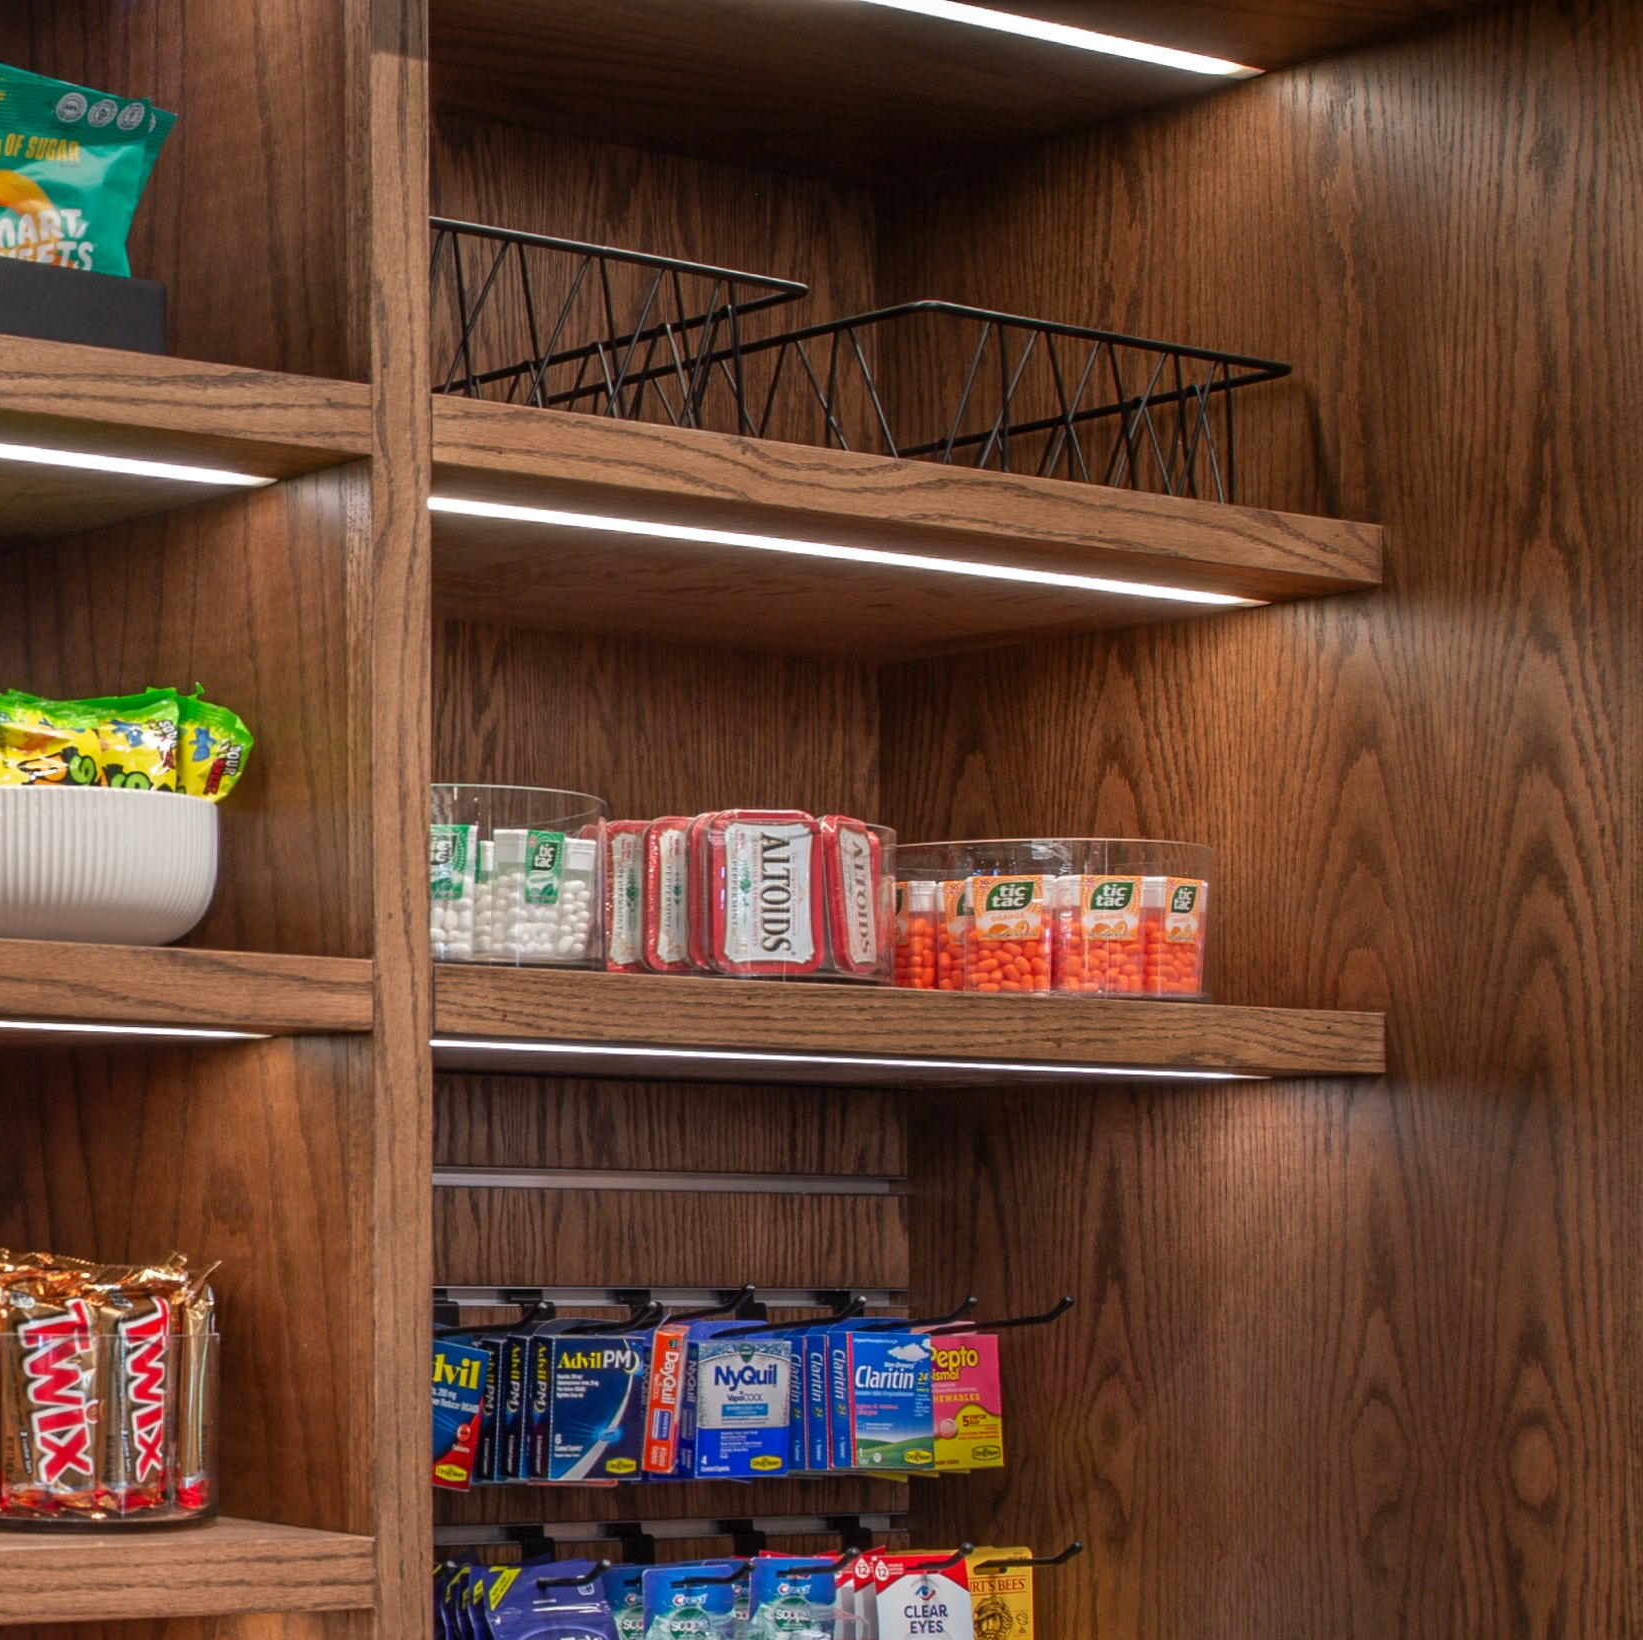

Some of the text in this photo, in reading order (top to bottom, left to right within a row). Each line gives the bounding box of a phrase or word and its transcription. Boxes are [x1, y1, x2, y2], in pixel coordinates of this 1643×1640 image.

[6, 129, 24, 157] OF
[26, 137, 80, 164] SUGAR
[538, 841, 556, 857] tic
[534, 855, 552, 870] tac
[761, 831, 791, 952] ALTOIDS
[852, 841, 870, 953] ALTOIDS
[1000, 885, 1026, 898] tic
[1103, 884, 1125, 898] tic
[1177, 888, 1194, 899] tic
[992, 896, 1024, 908] tac
[1095, 894, 1125, 907] tac
[1173, 898, 1192, 910] tac
[990, 913, 1025, 921] ORANGE
[557, 1350, 631, 1370] Advil PM
[661, 1350, 679, 1405] DayQuil
[714, 1364, 778, 1391] NyQuil
[810, 1352, 823, 1403] Claritin
[832, 1349, 845, 1402] Claritin
[17, 1298, 101, 1483] TWIX
[700, 1455, 707, 1466] 4
[877, 1567, 887, 1578] 12
[778, 1584, 812, 1596] Crest
[998, 1578, 1025, 1591] BEES
[673, 1593, 708, 1606] Crest
[904, 1604, 948, 1619] CLEAR
[910, 1620, 944, 1634] EYES
